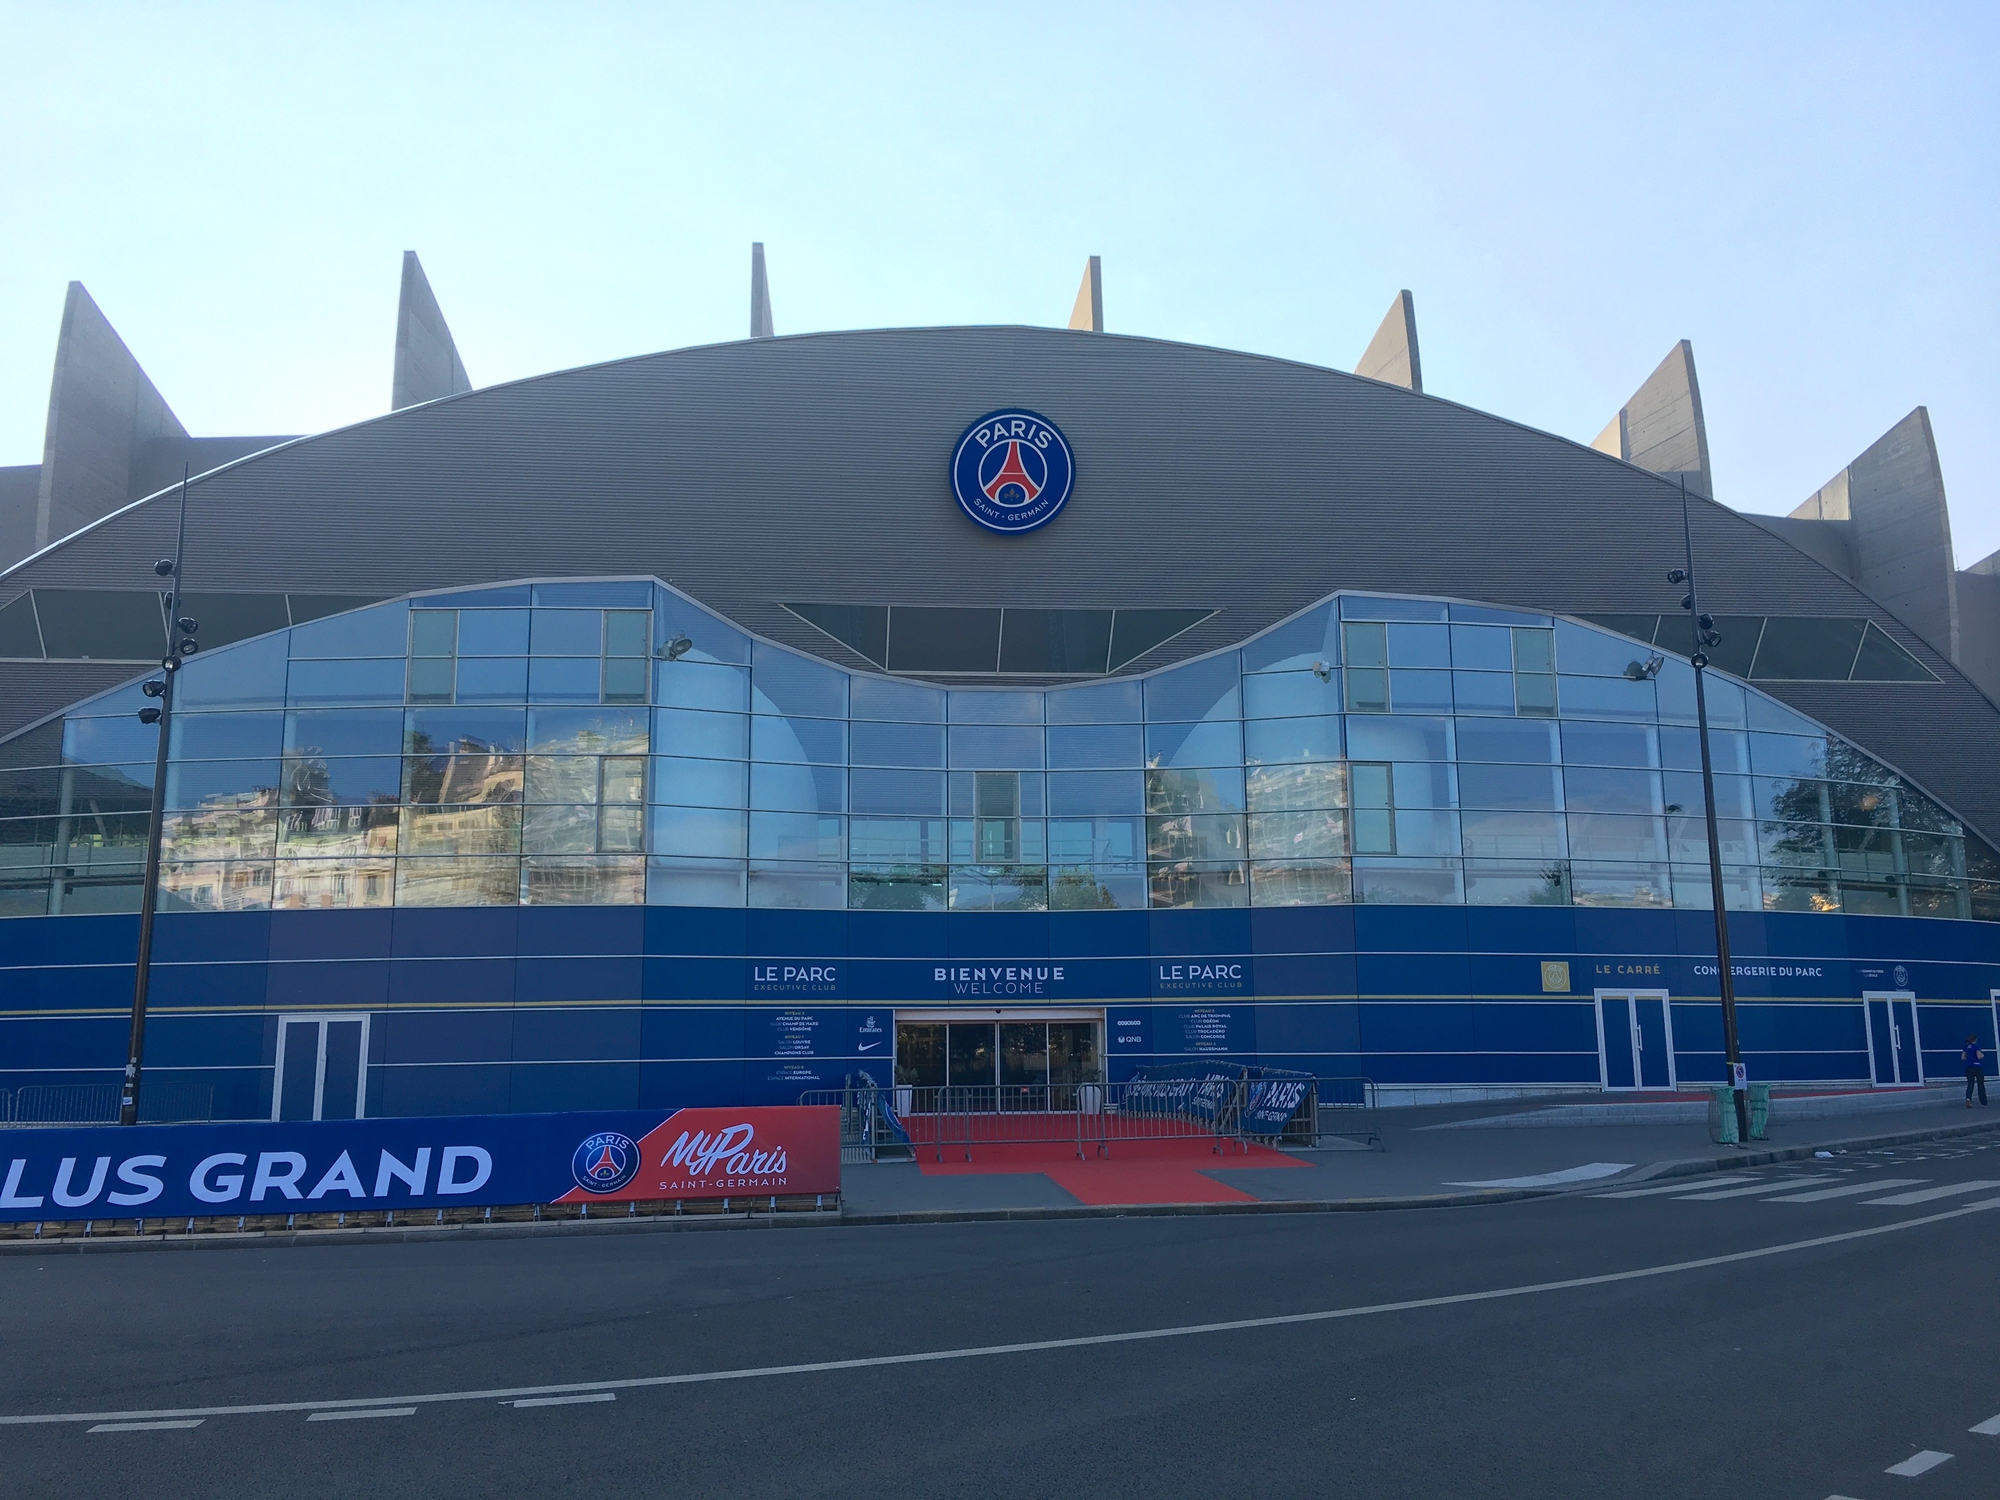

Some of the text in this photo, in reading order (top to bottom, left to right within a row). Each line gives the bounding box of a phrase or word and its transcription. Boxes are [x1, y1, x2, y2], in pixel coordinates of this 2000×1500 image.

[974, 420, 1053, 449] PARIS
[754, 966, 836, 982] LE PARC
[934, 967, 1065, 981] BIENVENUE
[1159, 964, 1242, 980] LE PARC
[1595, 963, 1661, 975] LE CARRÉ
[1693, 965, 1822, 977] CONERGERIE DU PARC
[954, 982, 1044, 994] WELCOME
[584, 1135, 630, 1150] PARIS
[189, 1145, 493, 1203] GRAND
